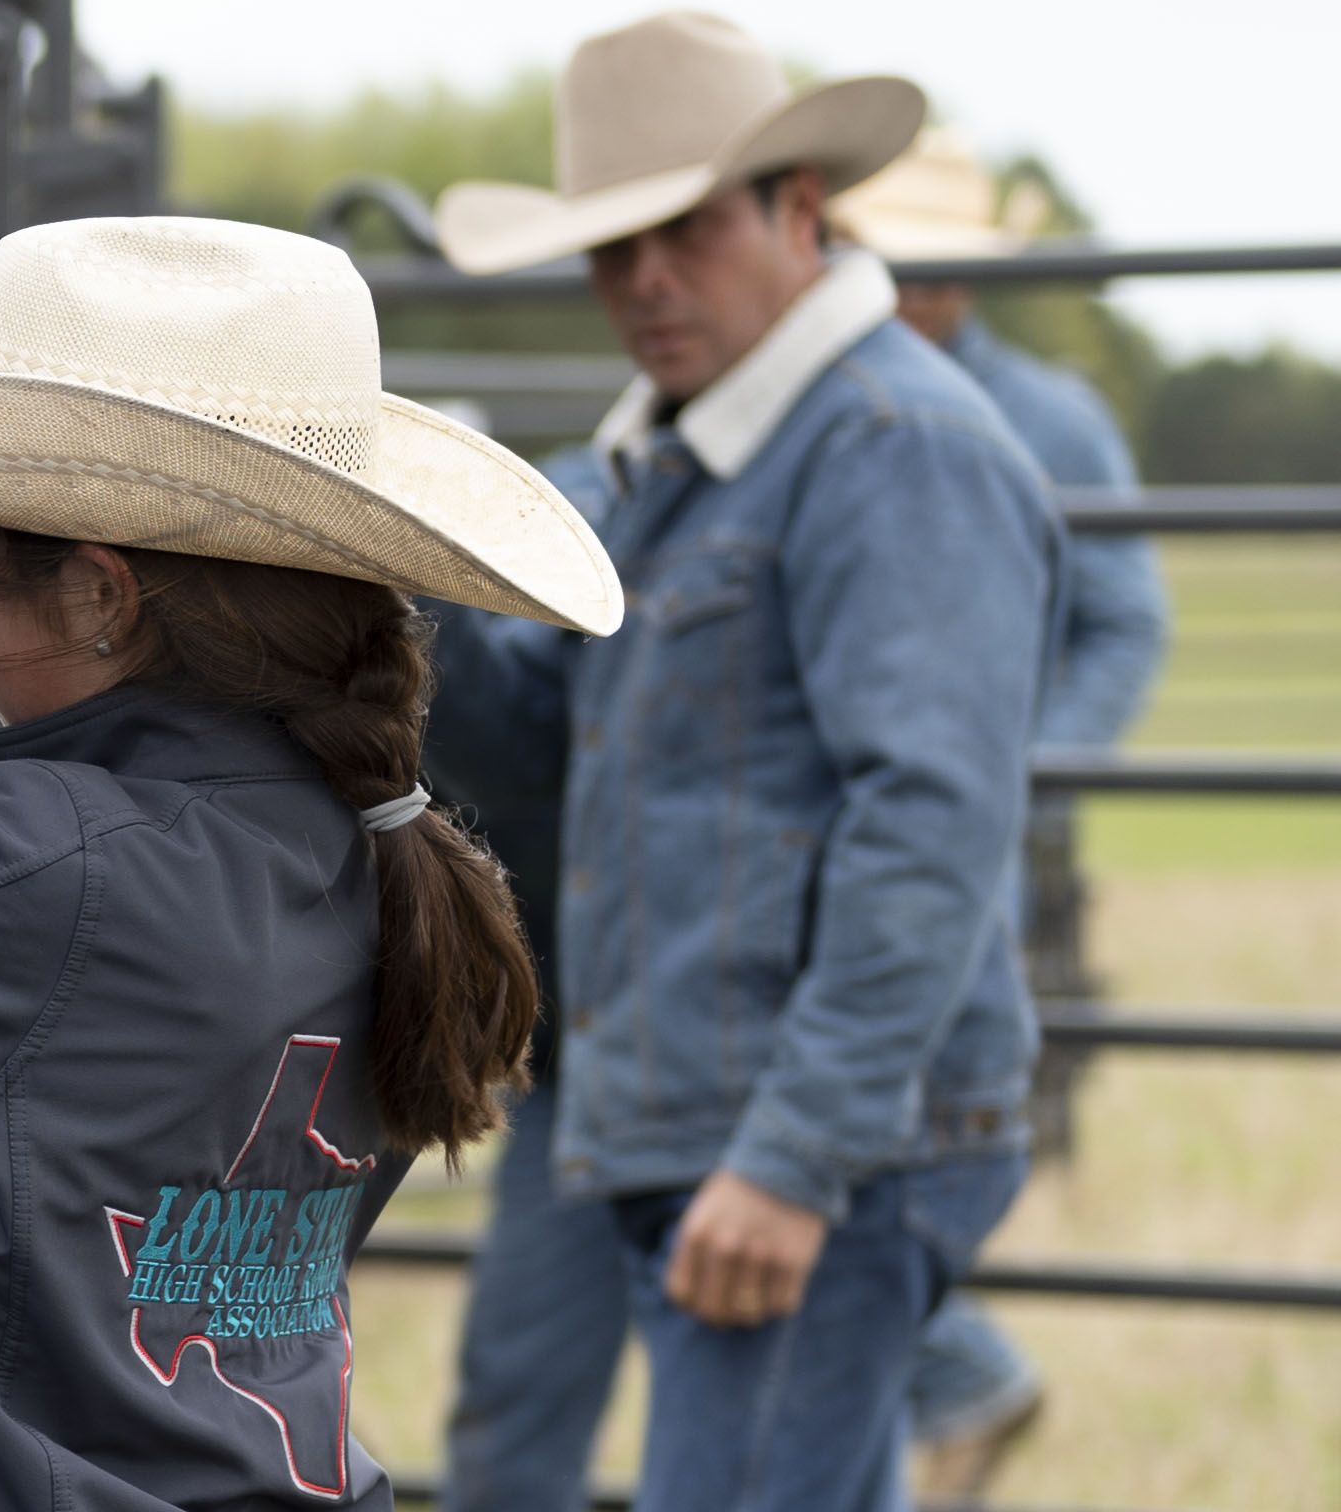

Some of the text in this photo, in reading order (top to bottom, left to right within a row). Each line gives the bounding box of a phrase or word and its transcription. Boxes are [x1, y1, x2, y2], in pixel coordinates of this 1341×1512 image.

[134, 1185, 287, 1265] LONE
[126, 1259, 210, 1303] HIGH
[207, 1264, 301, 1305] SCHOOL
[204, 1297, 337, 1339] ASSOCIATION
